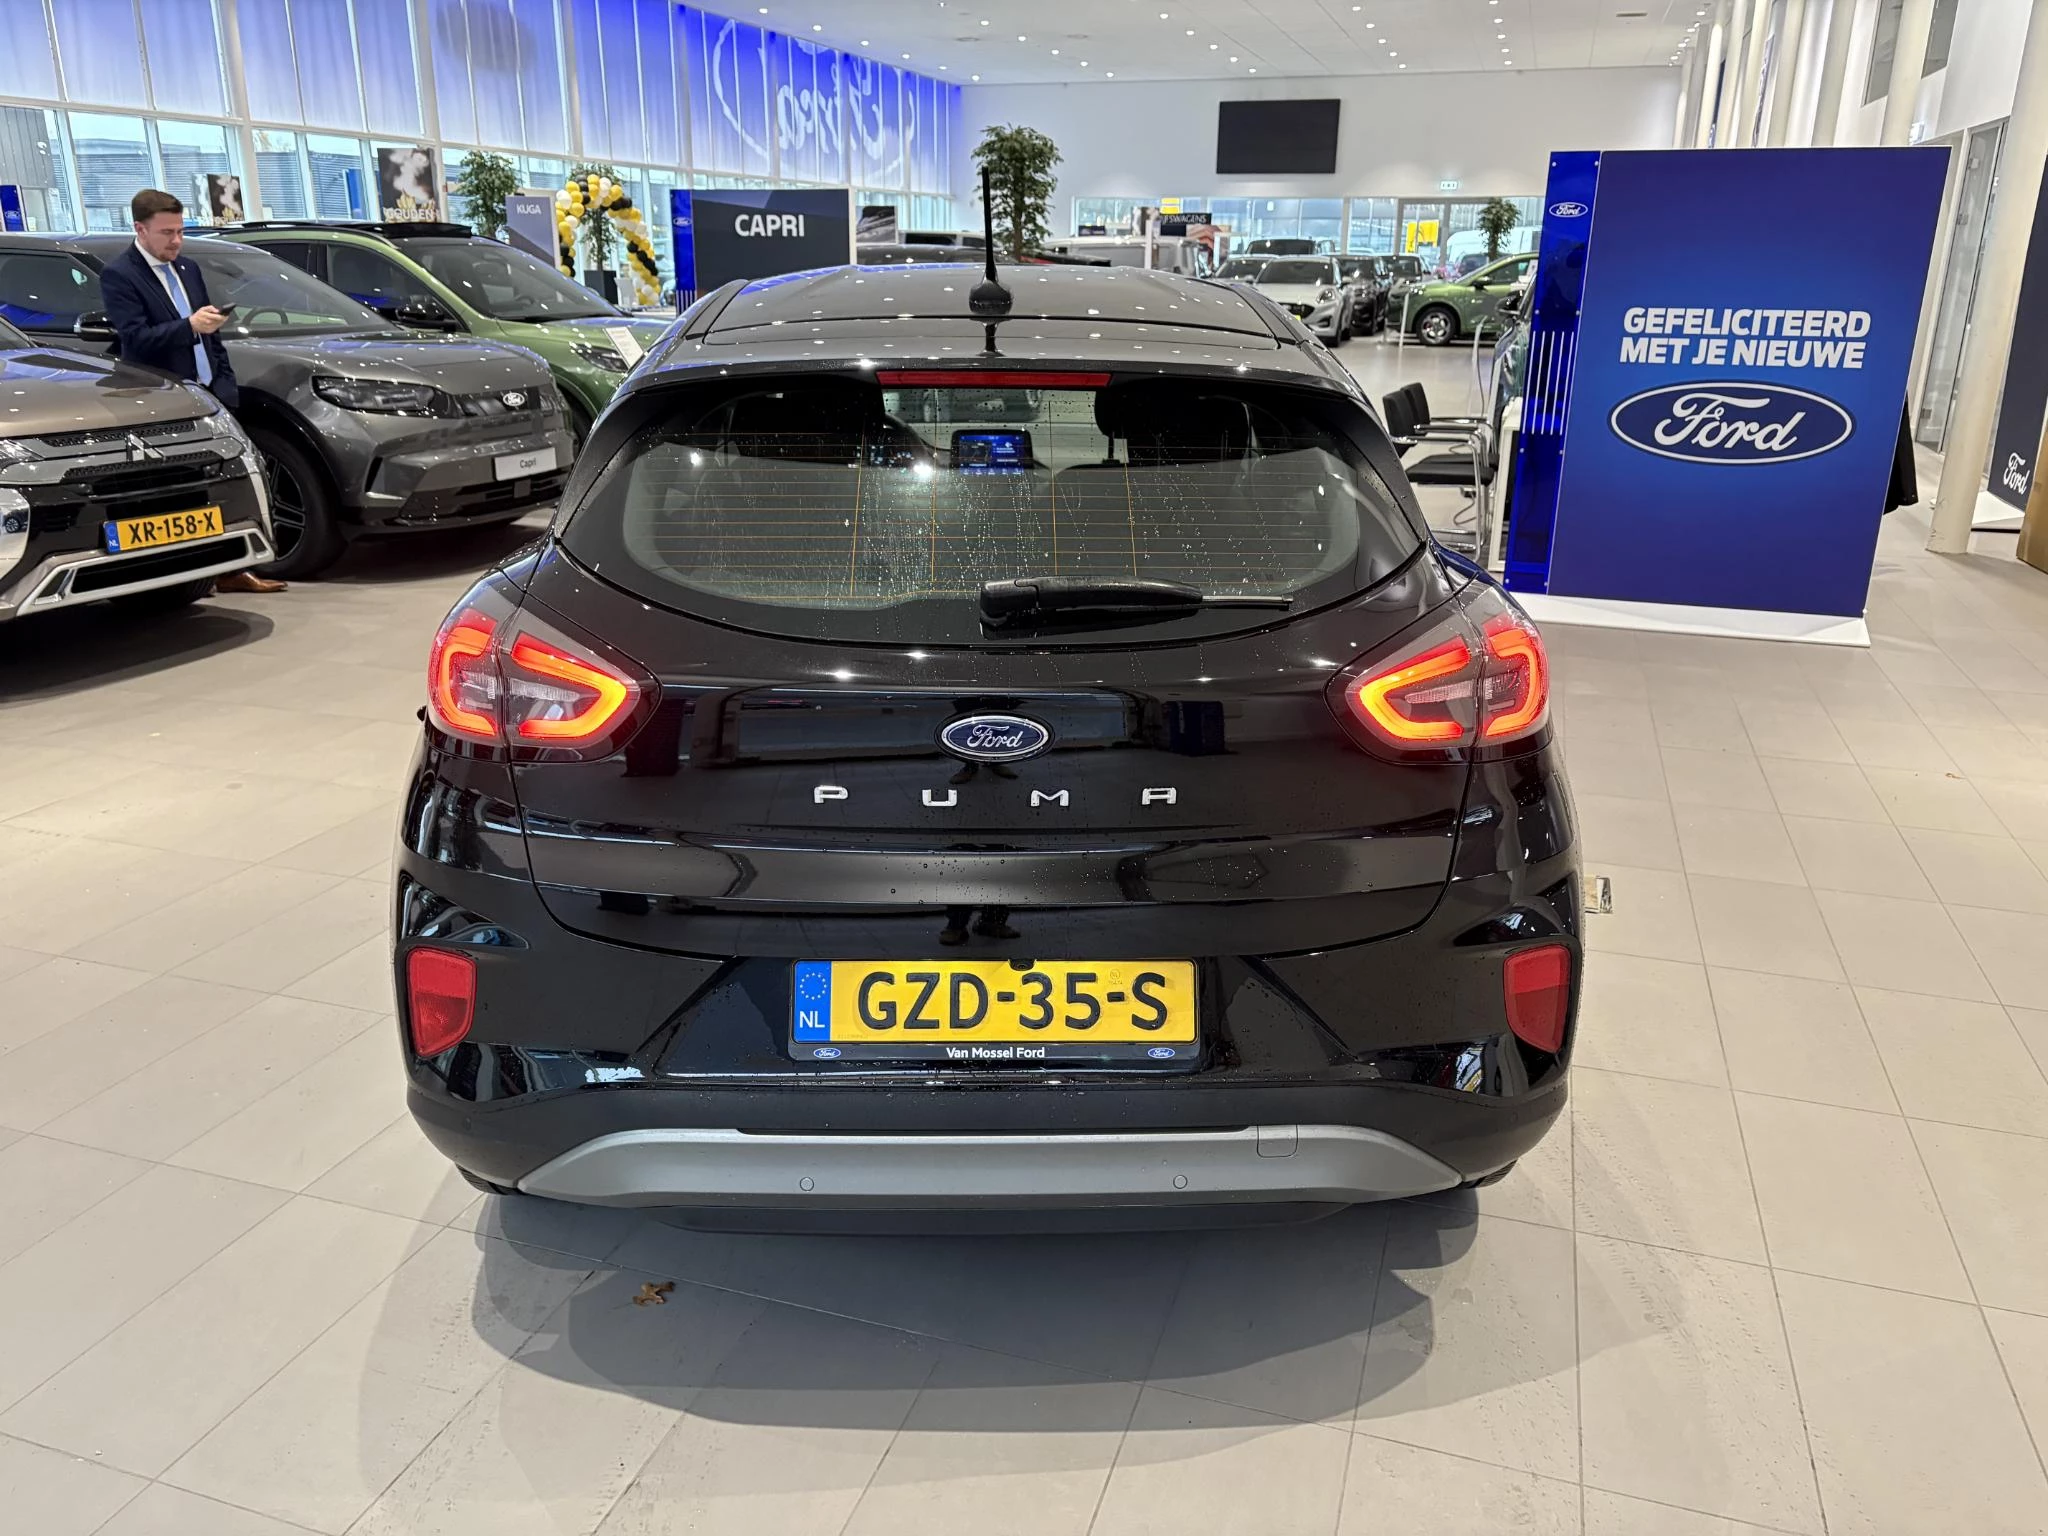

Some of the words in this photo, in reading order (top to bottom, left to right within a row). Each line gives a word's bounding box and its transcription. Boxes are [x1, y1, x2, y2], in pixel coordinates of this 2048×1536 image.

[516, 204, 541, 214] KUGA
[734, 213, 805, 237] CAPRI
[1623, 307, 1872, 338] GEFELICITEERD
[1619, 336, 1690, 364] MET
[1691, 338, 1728, 365] JE
[1731, 339, 1867, 368] NIEUWE
[1653, 392, 1806, 451] Ford
[519, 457, 537, 469] Capri
[2003, 452, 2031, 495] Ford
[128, 511, 216, 545] XR-158-X
[108, 539, 119, 547] NL
[813, 784, 1178, 807] PUMA
[857, 970, 1168, 1031] GZD-35-S
[799, 1010, 826, 1029] NL
[945, 1047, 969, 1059] Van
[971, 1047, 1014, 1059] Mossel
[1016, 1047, 1046, 1059] Ford
